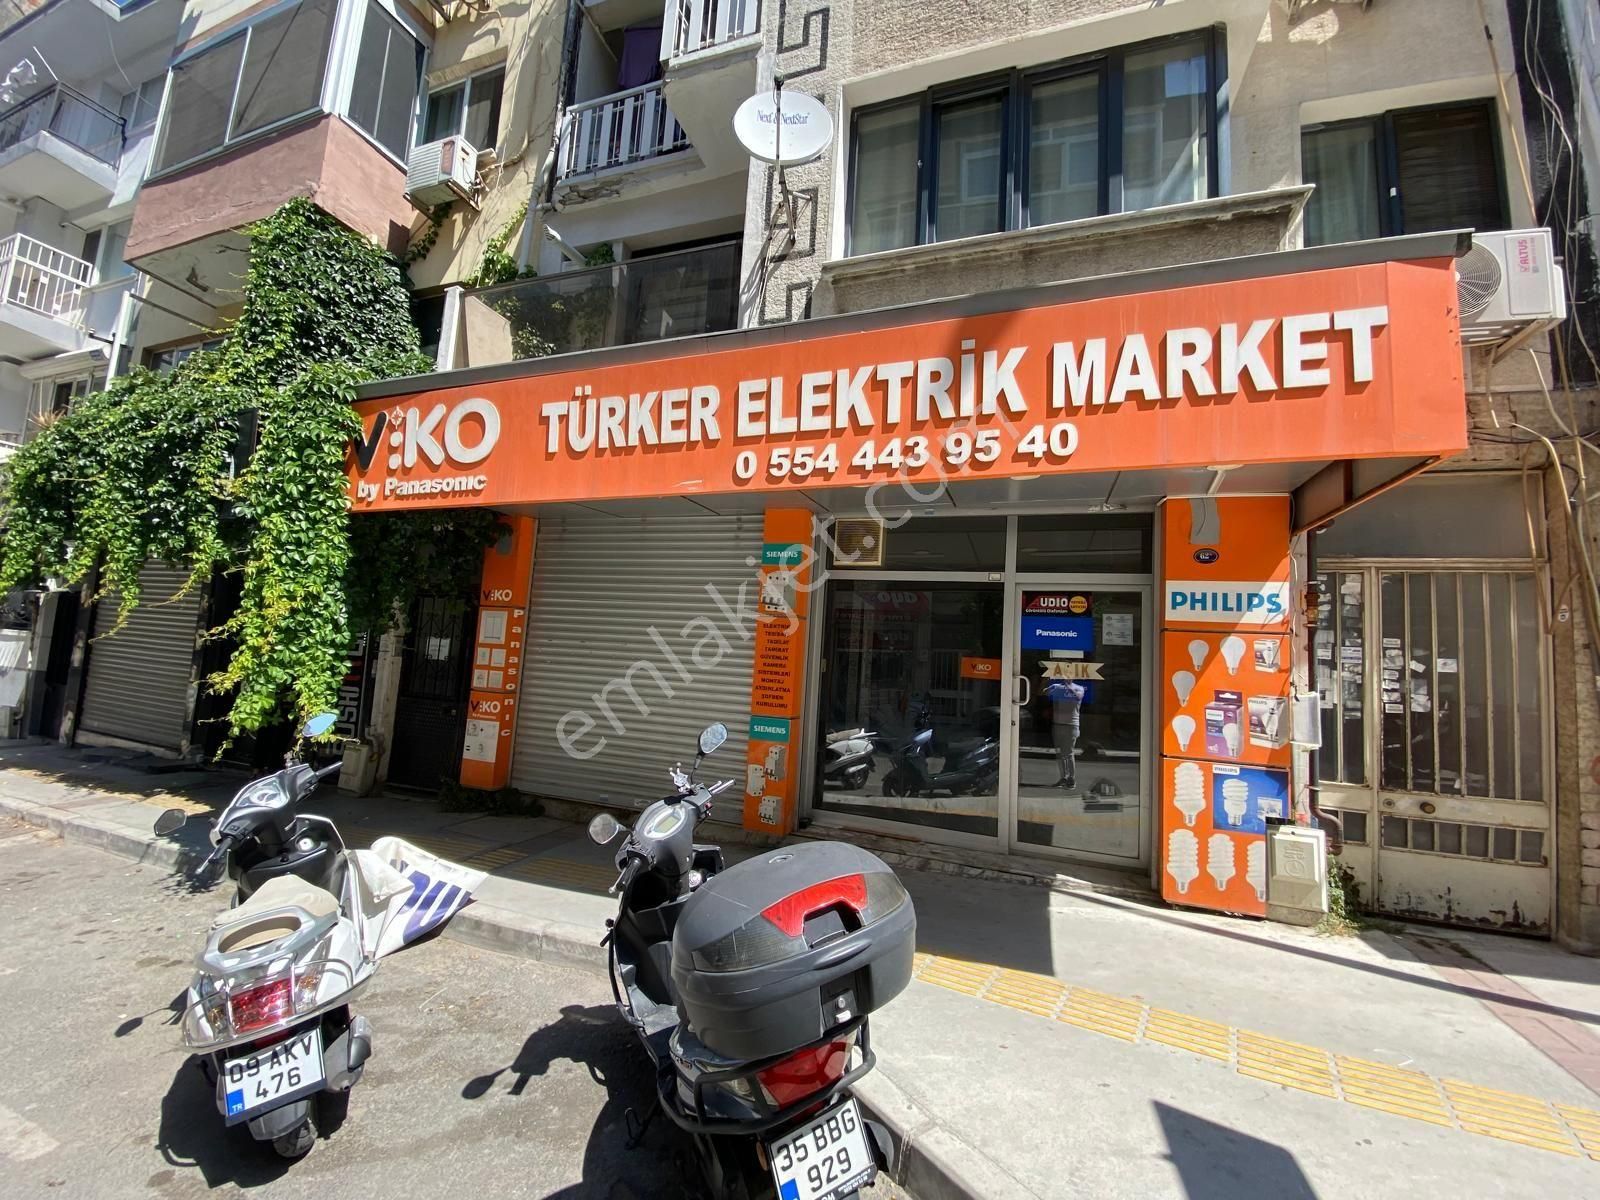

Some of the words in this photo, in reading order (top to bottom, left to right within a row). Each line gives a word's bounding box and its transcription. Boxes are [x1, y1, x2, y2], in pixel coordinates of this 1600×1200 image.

[1518, 239, 1529, 265] ALTUS
[541, 386, 720, 453] TÜRKER
[736, 339, 1029, 438] ELEKTRİK
[1052, 305, 1388, 408] MARKET
[735, 450, 757, 479] 0
[769, 439, 839, 477] 554
[851, 435, 929, 472] 443
[946, 428, 1001, 464] 95
[1016, 422, 1079, 459] 40
[357, 480, 377, 501] by
[385, 473, 488, 497] Panasonic
[766, 550, 798, 559] SIEMENS
[1171, 591, 1282, 613] PHILIPS
[1036, 629, 1078, 638] Panasonic
[500, 609, 525, 736] Panasonic
[753, 724, 786, 734] SIEMENS
[230, 1057, 260, 1083] 09
[270, 1036, 313, 1070] AKV
[256, 1066, 301, 1098] 476
[231, 1103, 243, 1112] TR
[777, 1134, 808, 1171] 35
[812, 1107, 855, 1152] BBG
[807, 1146, 851, 1192] 929
